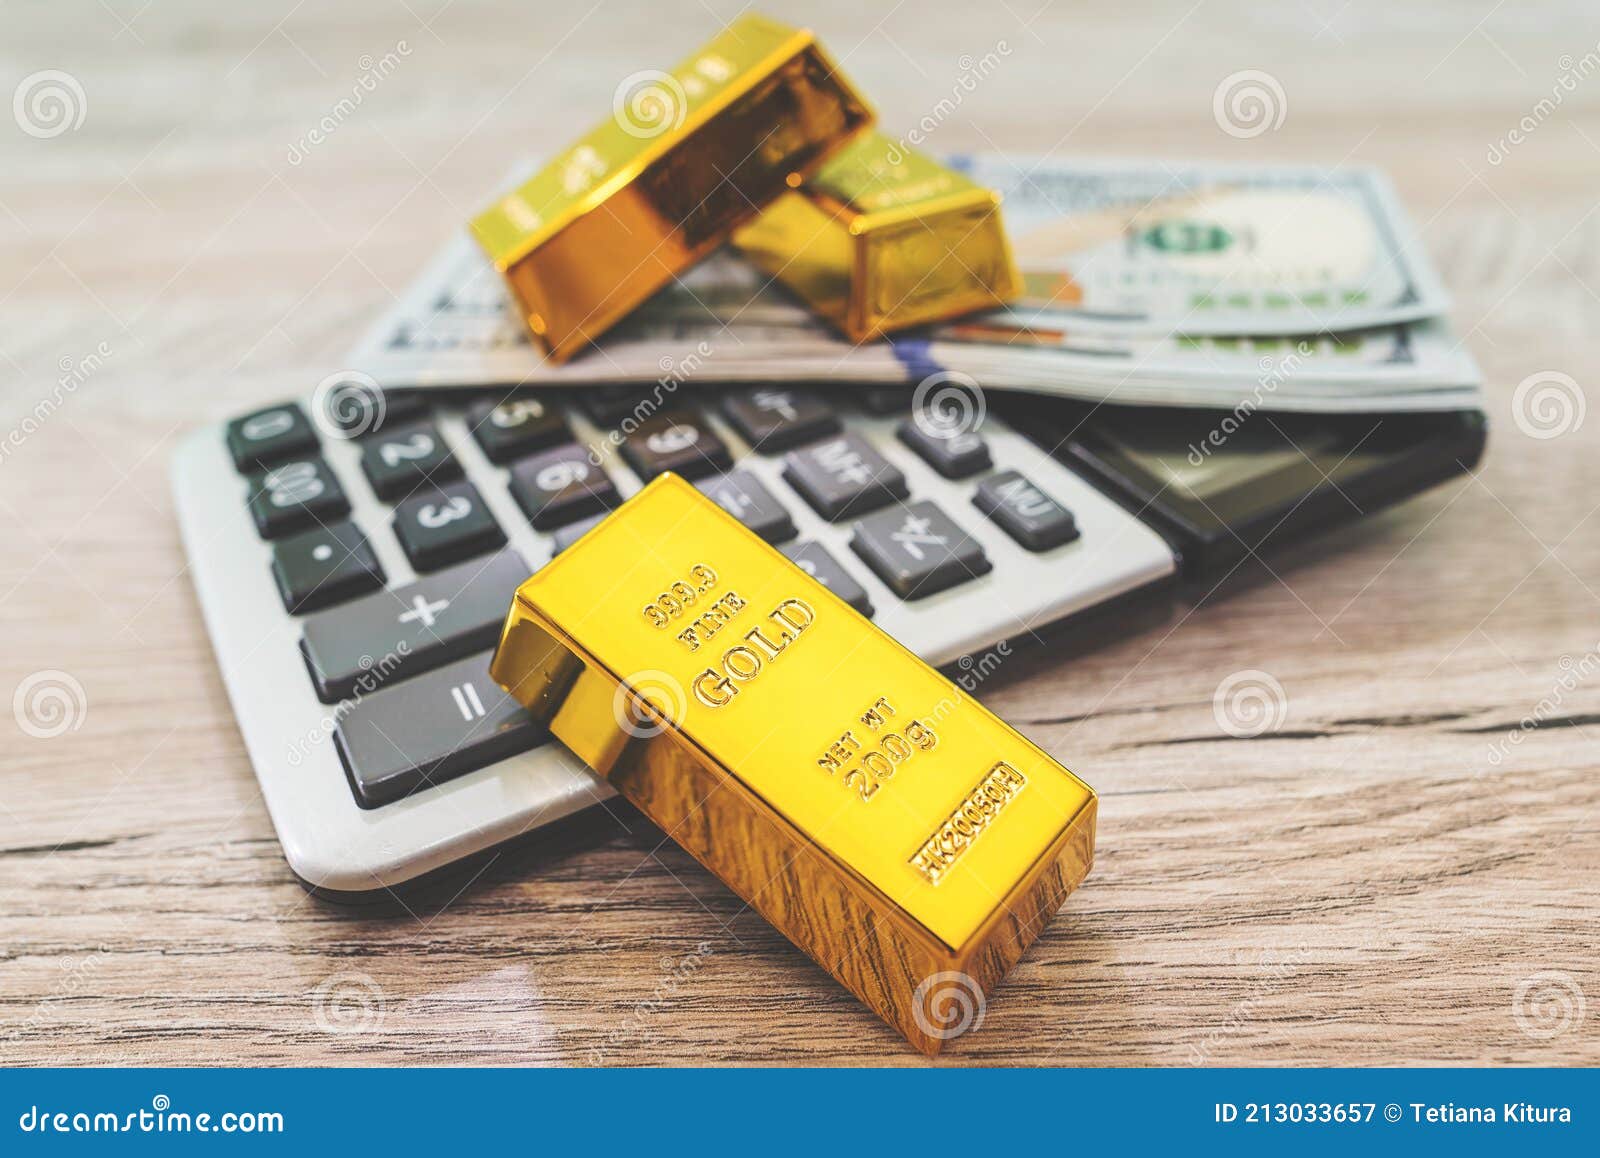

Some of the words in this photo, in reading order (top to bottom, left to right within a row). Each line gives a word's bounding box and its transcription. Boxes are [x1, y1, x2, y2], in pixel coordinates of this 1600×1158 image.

[379, 433, 435, 467] 2
[535, 460, 589, 491] 6
[416, 496, 473, 529] 3
[642, 563, 719, 630] 999.9
[677, 591, 748, 652] FINE
[691, 597, 817, 708] GOLD
[817, 731, 862, 774] NET
[860, 697, 896, 732] WT
[843, 719, 940, 803] 200g
